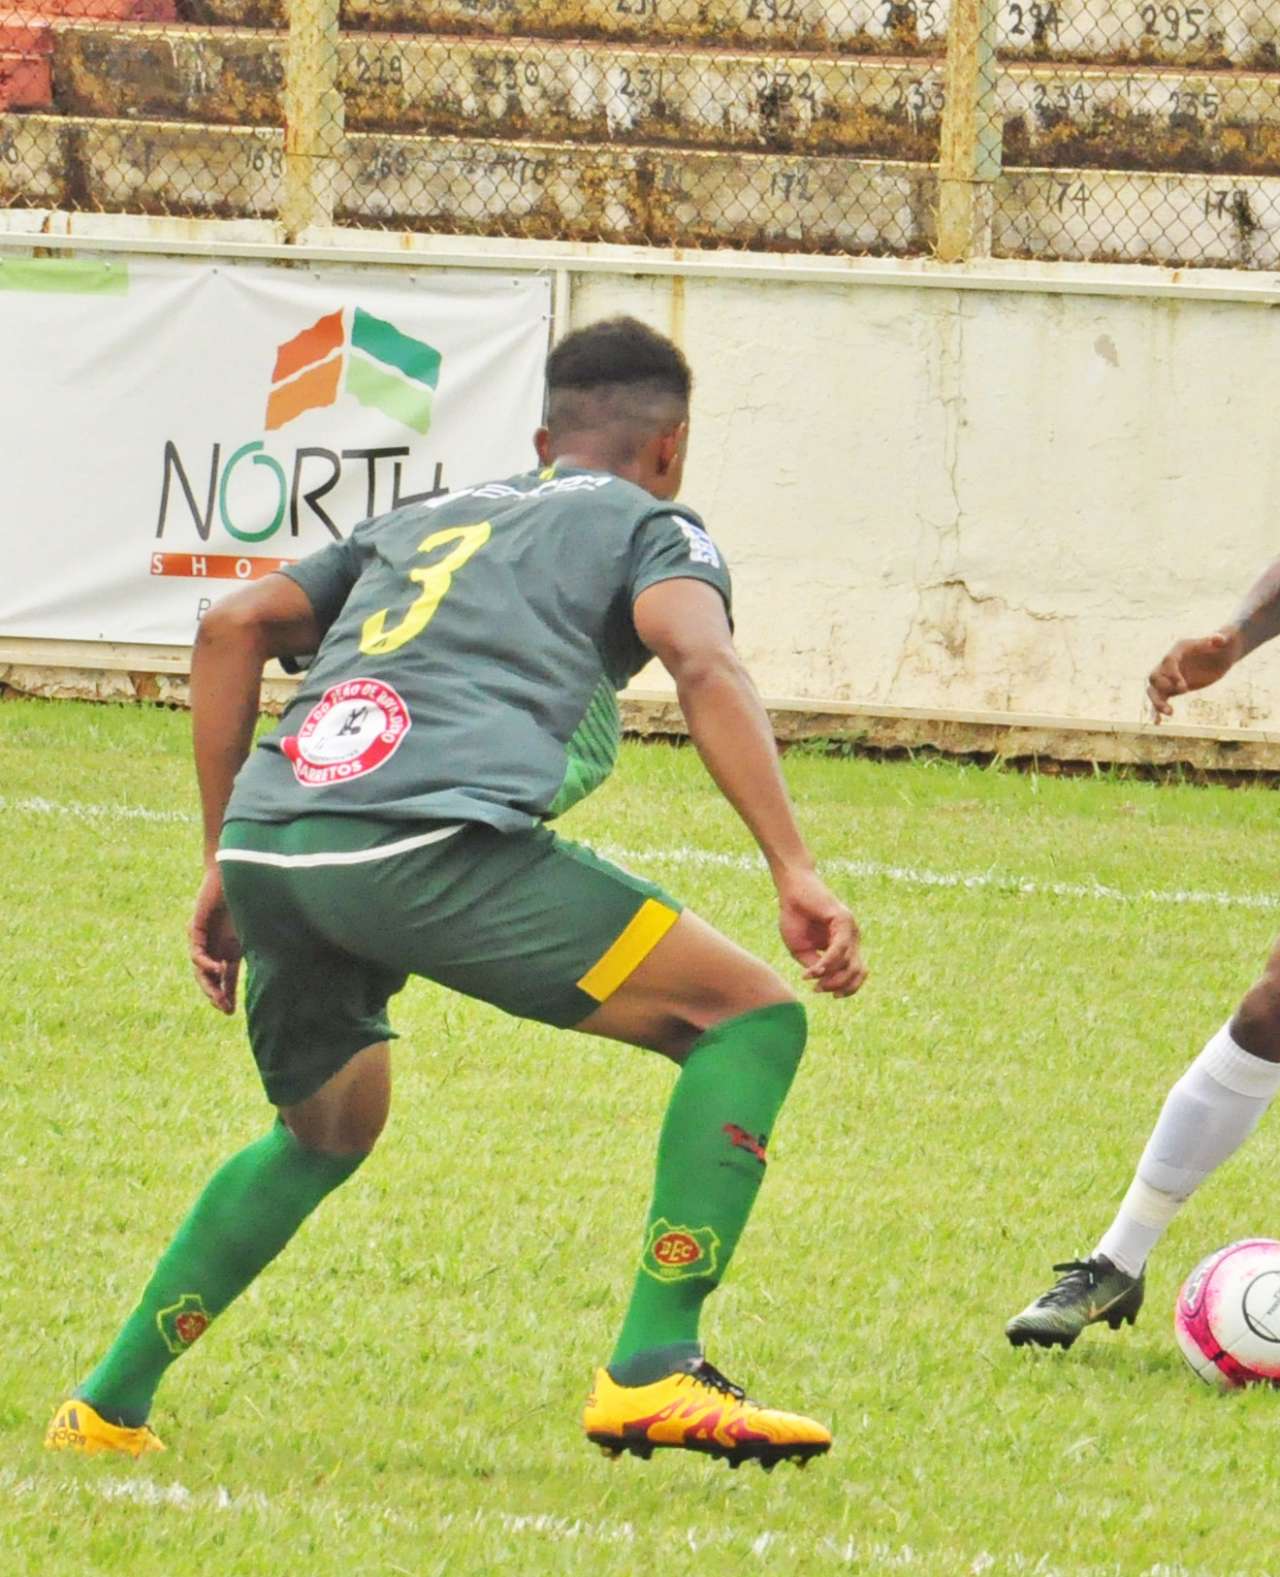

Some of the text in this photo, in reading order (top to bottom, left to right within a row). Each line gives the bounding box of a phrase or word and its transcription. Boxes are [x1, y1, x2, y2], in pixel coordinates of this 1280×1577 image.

[1141, 5, 1206, 41] 295
[1045, 182, 1090, 216] 174
[156, 439, 449, 543] NORTH
[150, 554, 289, 580] SHO
[359, 521, 492, 656] 3
